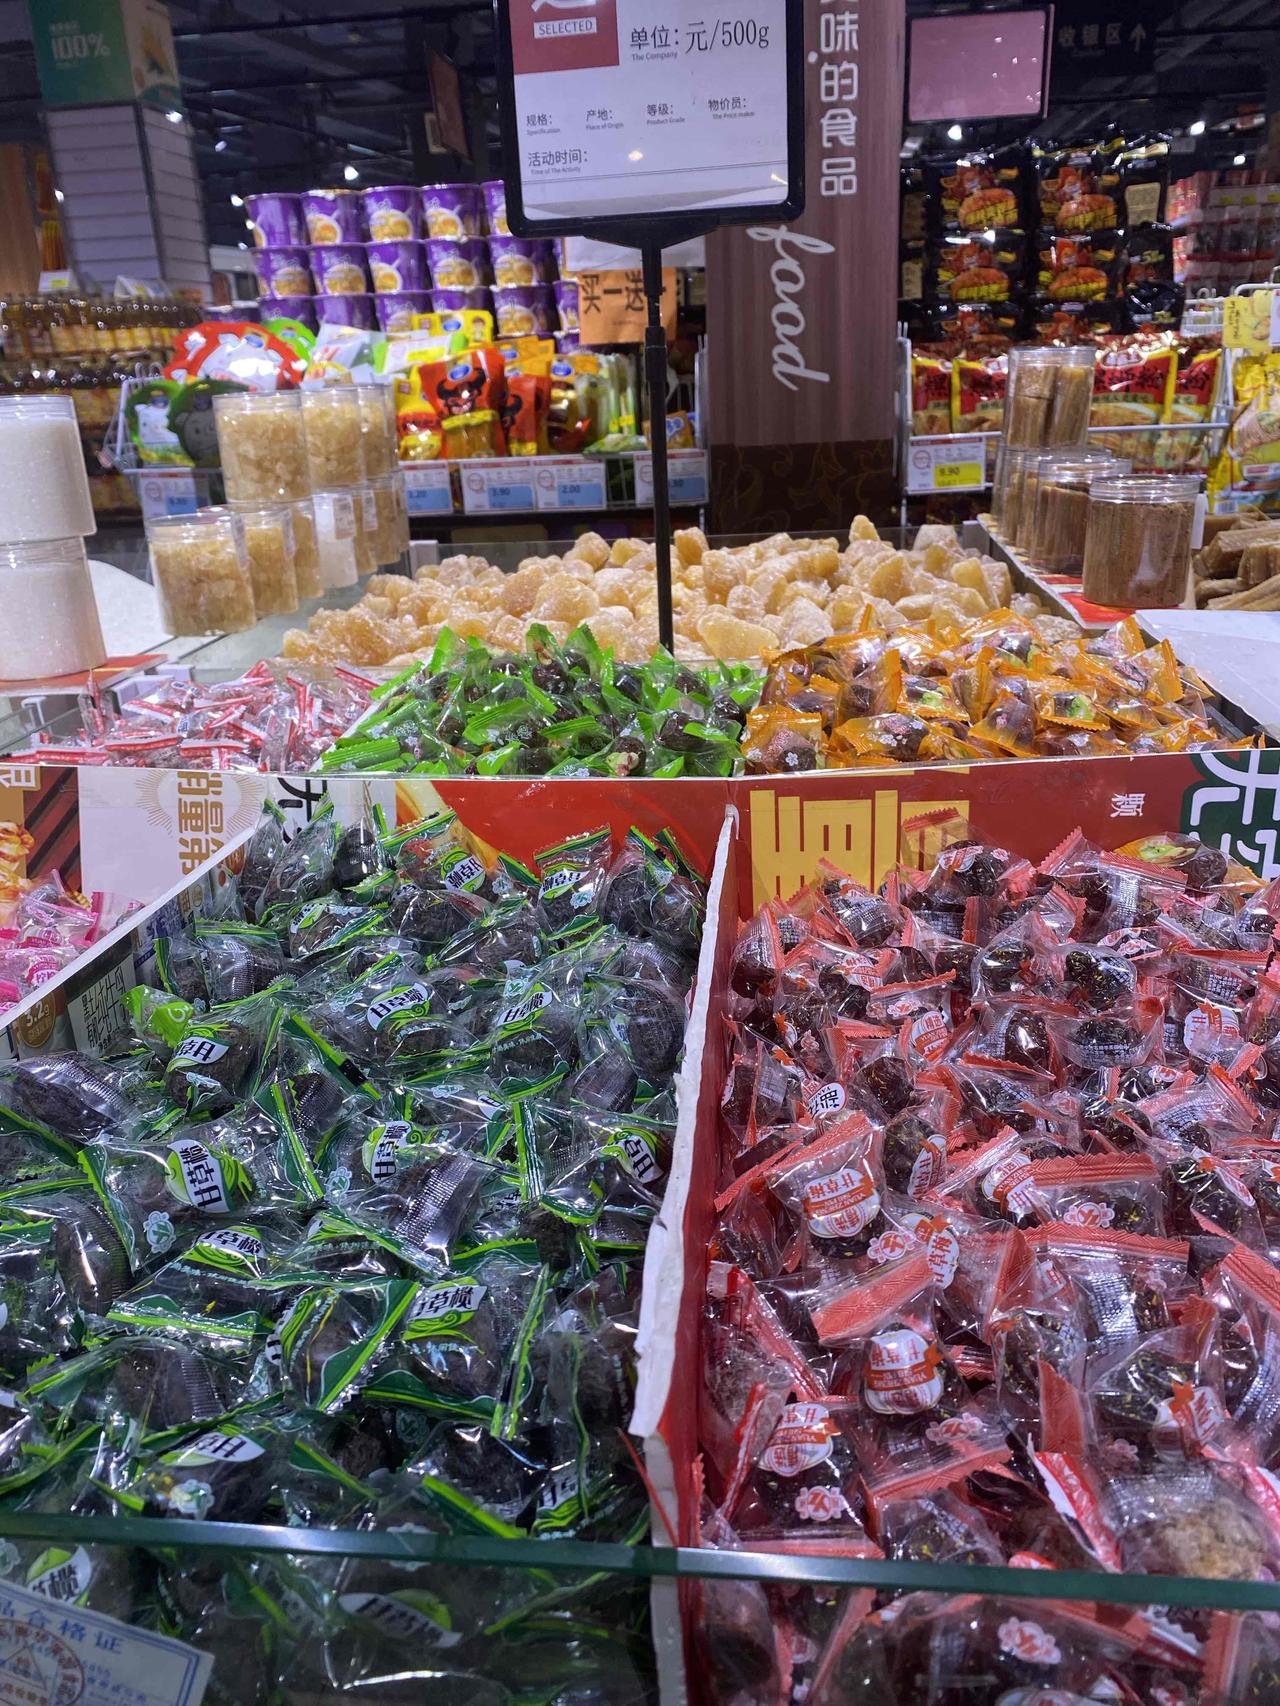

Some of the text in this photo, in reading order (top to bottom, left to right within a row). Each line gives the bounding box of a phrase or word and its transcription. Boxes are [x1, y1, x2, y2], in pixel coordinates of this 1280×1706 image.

[538, 20, 593, 36] SELECTED
[647, 51, 678, 62] Company
[820, 11, 859, 196] 味的食品
[580, 270, 667, 314] 买一送
[746, 225, 836, 391] food
[1110, 793, 1146, 817] 颗
[180, 1144, 222, 1209] 甘草榄
[809, 1172, 855, 1199] 甘草梅
